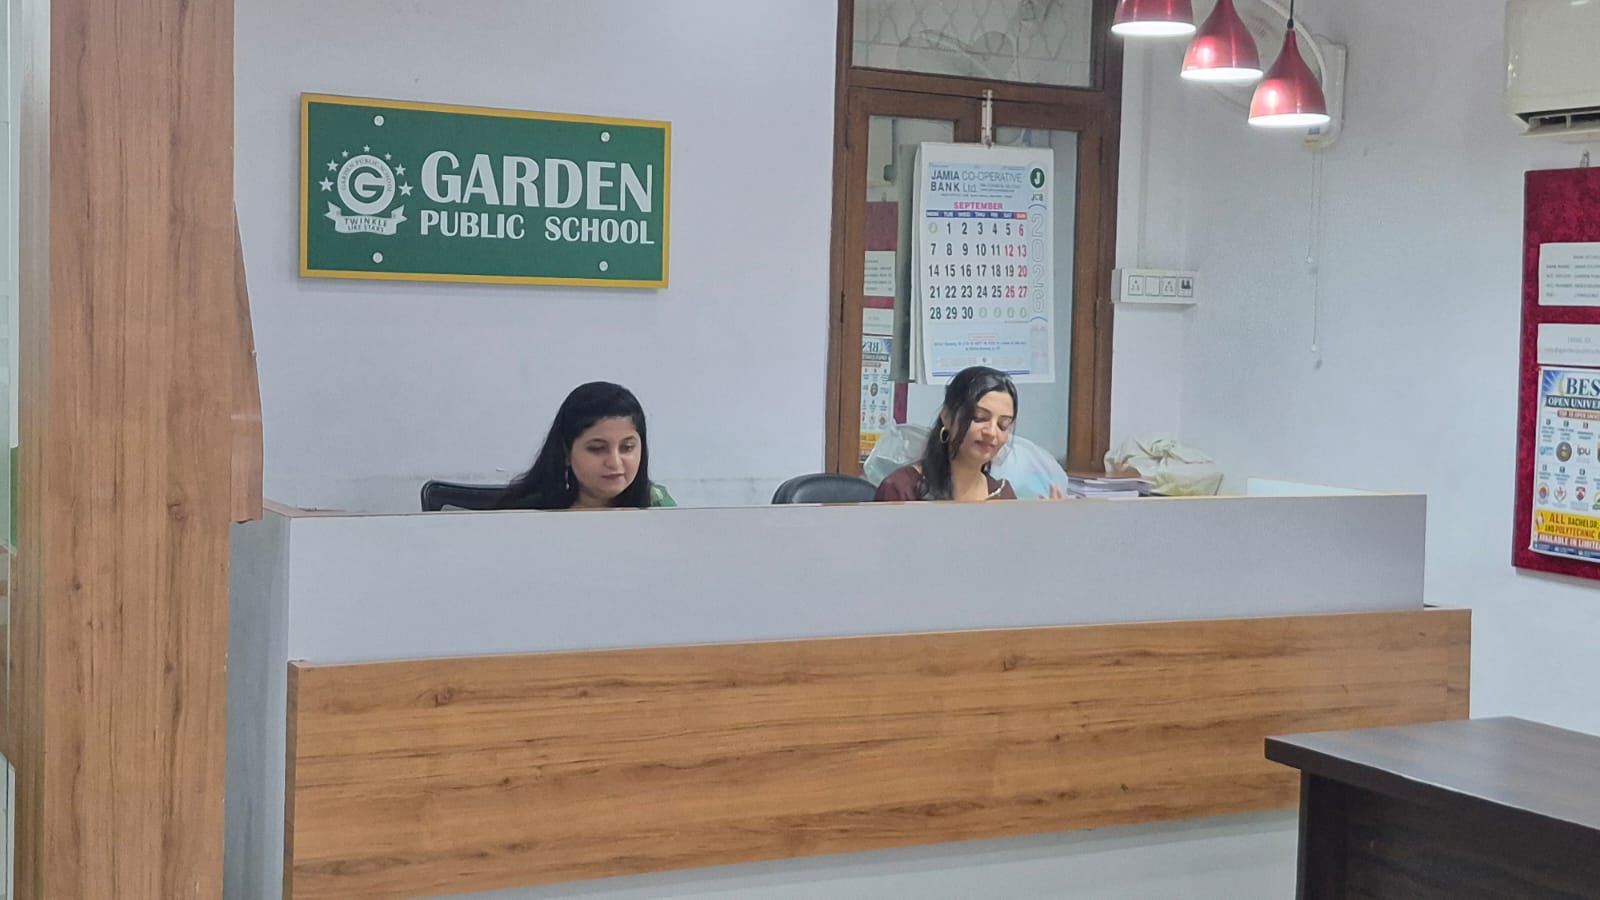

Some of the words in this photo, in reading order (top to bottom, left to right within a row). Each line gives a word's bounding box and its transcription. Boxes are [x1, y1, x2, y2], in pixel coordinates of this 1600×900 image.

[421, 150, 653, 213] GARDEN
[931, 170, 960, 181] JAMIA
[961, 171, 1023, 183] CO-OPERATIVE
[348, 166, 385, 204] G
[930, 182, 960, 192] BANK
[1031, 193, 1044, 202] JCB
[954, 202, 1003, 210] SEPTEMBER
[345, 217, 386, 227] TWINKLE
[420, 209, 525, 240] PUBLIC
[544, 216, 655, 244] SCHOOL
[946, 223, 952, 234] 1
[961, 222, 968, 234] 2
[977, 222, 984, 235] 3
[992, 223, 998, 234] 4
[1005, 223, 1011, 235] 5
[1018, 224, 1024, 236] 6
[930, 243, 937, 255] 7
[946, 243, 953, 255] 8
[962, 243, 969, 255] 9
[976, 244, 986, 256] 10
[991, 244, 1000, 256] 11
[1005, 244, 1013, 256] 12
[1018, 245, 1026, 257] 13
[929, 265, 939, 277] 14
[945, 264, 955, 277] 15
[961, 264, 971, 277] 16
[977, 265, 986, 276] 17
[992, 264, 1001, 277] 18
[1005, 265, 1014, 277] 19
[1018, 265, 1027, 277] 20
[930, 286, 940, 298] 21
[945, 286, 956, 298] 22
[961, 285, 972, 298] 23
[977, 286, 987, 298] 24
[992, 285, 1001, 298] 25
[1006, 286, 1015, 298] 26
[1019, 286, 1027, 298] 27
[930, 307, 941, 319] 28
[946, 307, 957, 319] 29
[962, 307, 973, 319] 30
[1548, 397, 1569, 407] OPEN
[1570, 399, 1600, 409] UNIVE
[1577, 444, 1590, 456] ipu
[1550, 513, 1564, 524] ALL
[1545, 524, 1554, 533] AND
[1555, 526, 1595, 539] POLYTECHNIC
